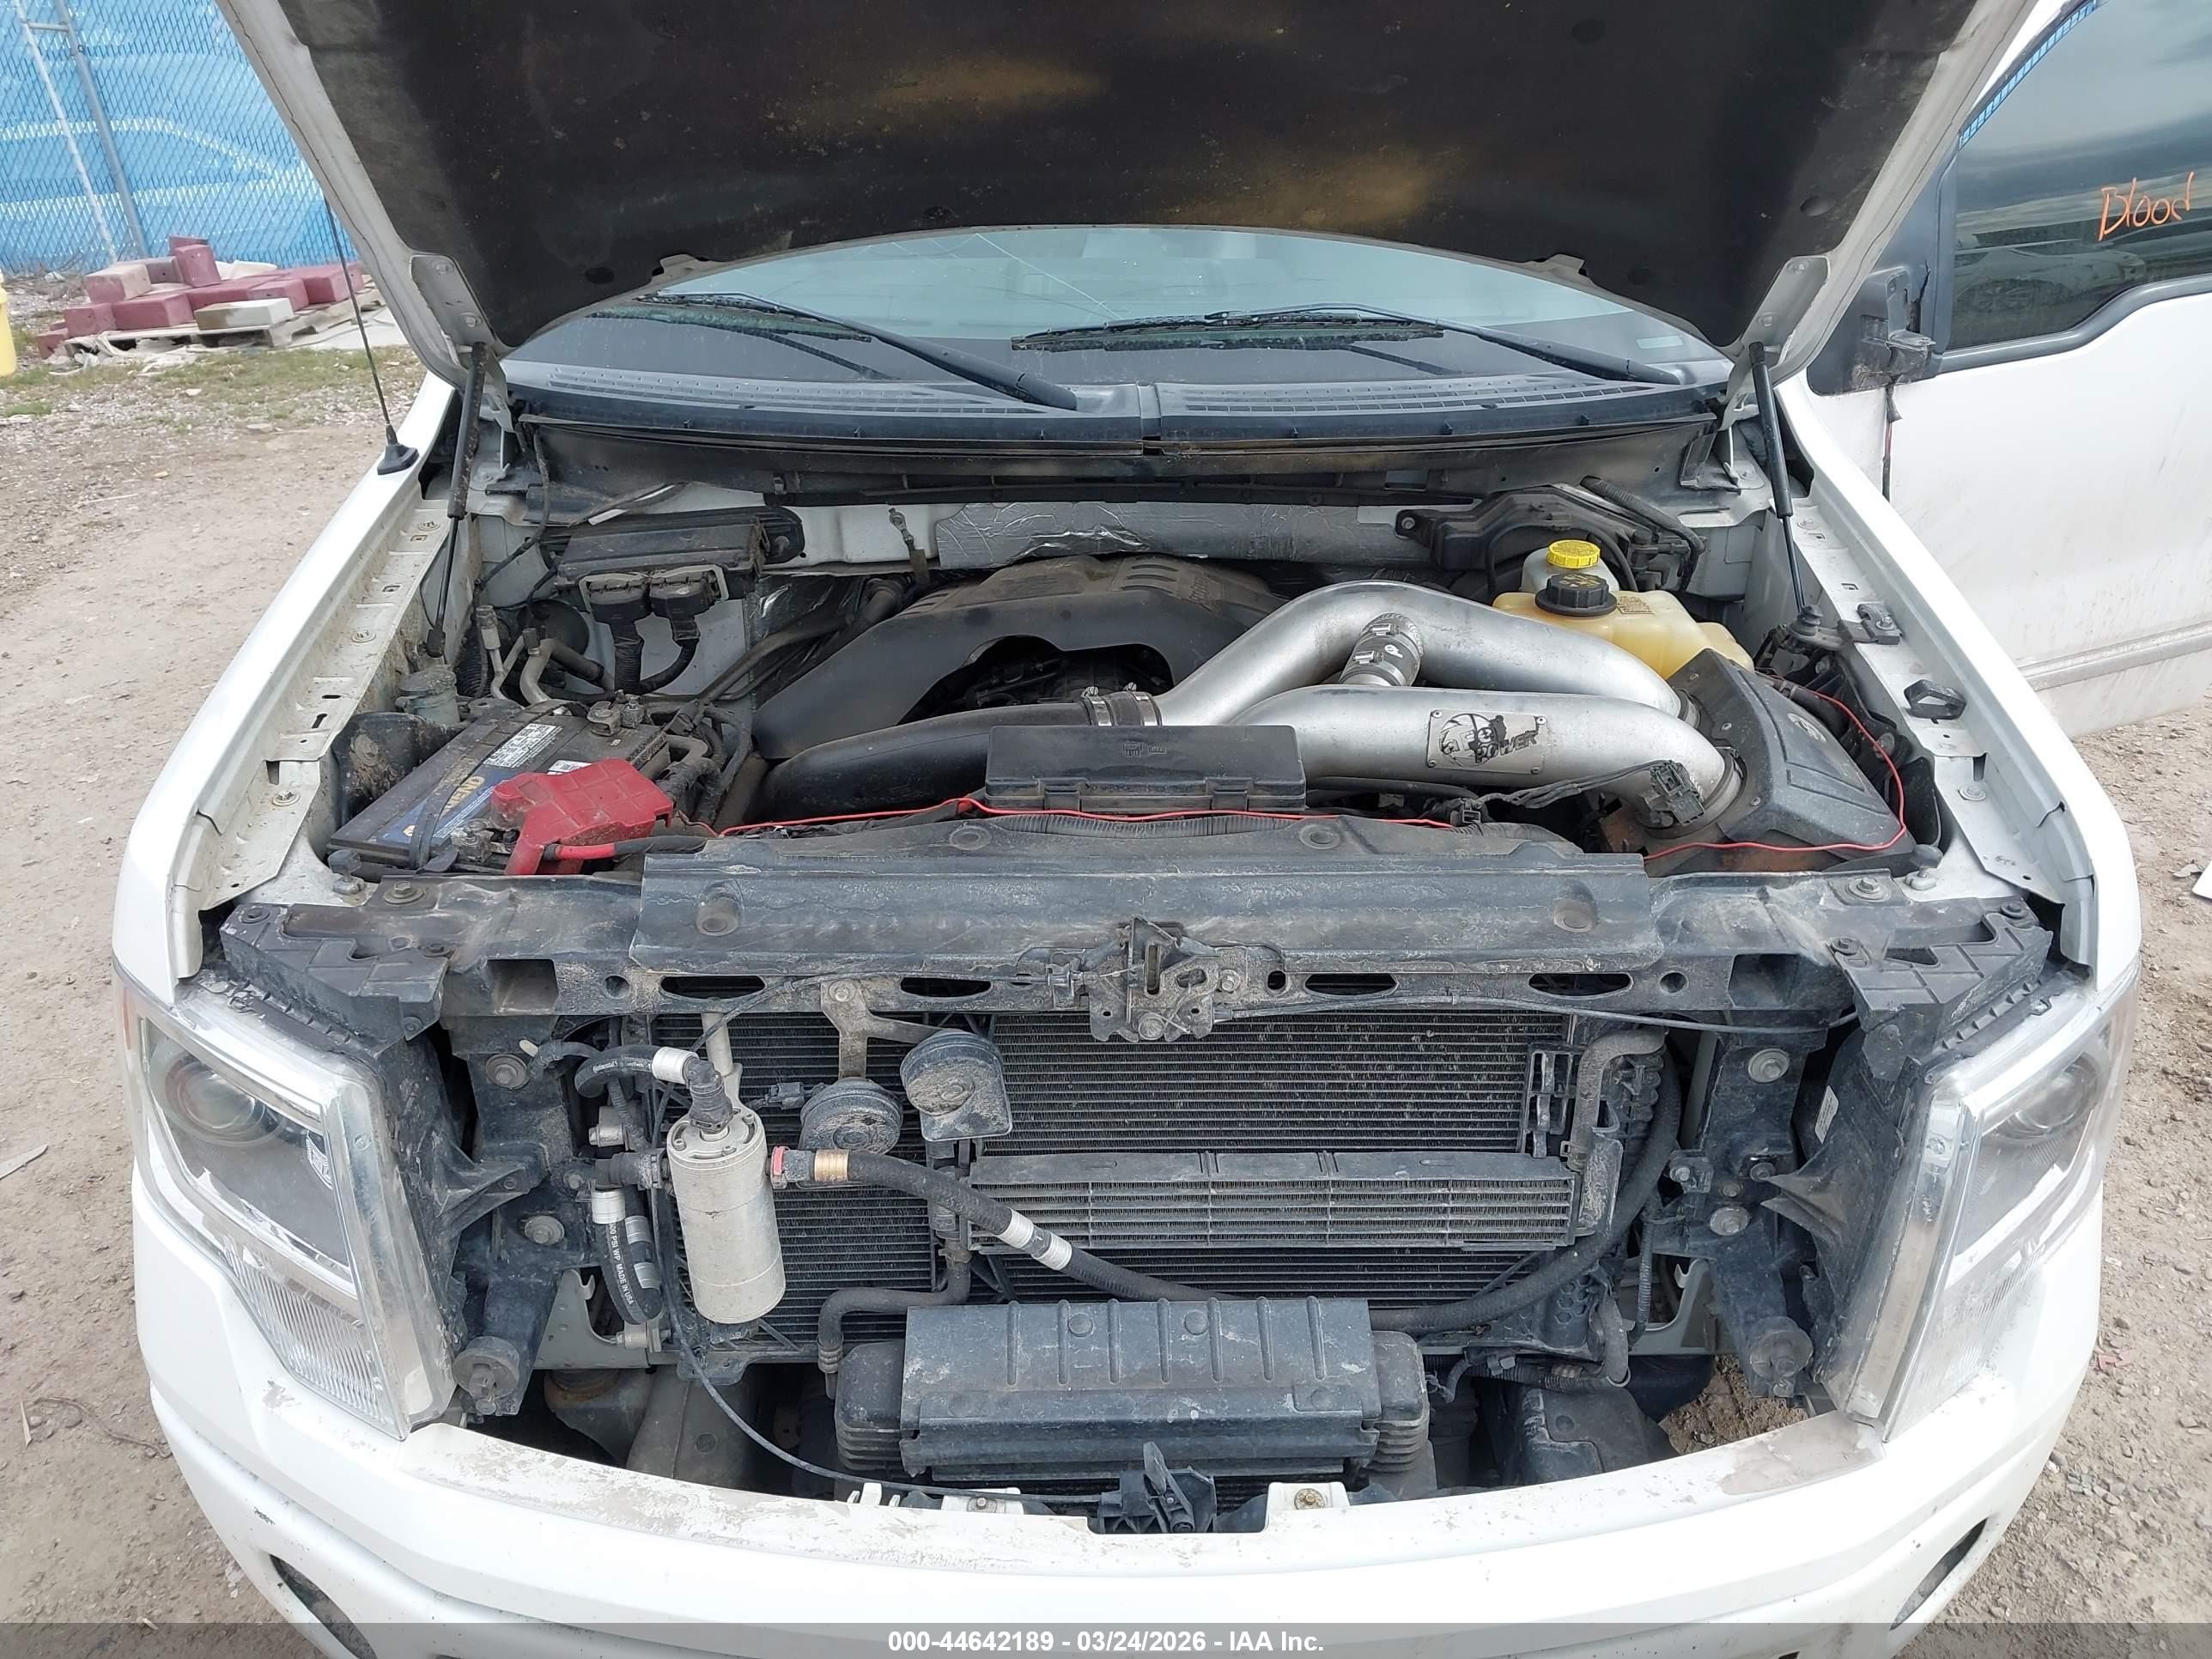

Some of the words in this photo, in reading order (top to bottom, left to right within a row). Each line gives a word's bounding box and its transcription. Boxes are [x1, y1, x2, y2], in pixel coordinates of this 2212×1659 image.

[611, 1236, 619, 1249] PSI
[616, 1263, 627, 1284] MADE
[621, 1283, 631, 1291] IN
[624, 1291, 635, 1305] USA
